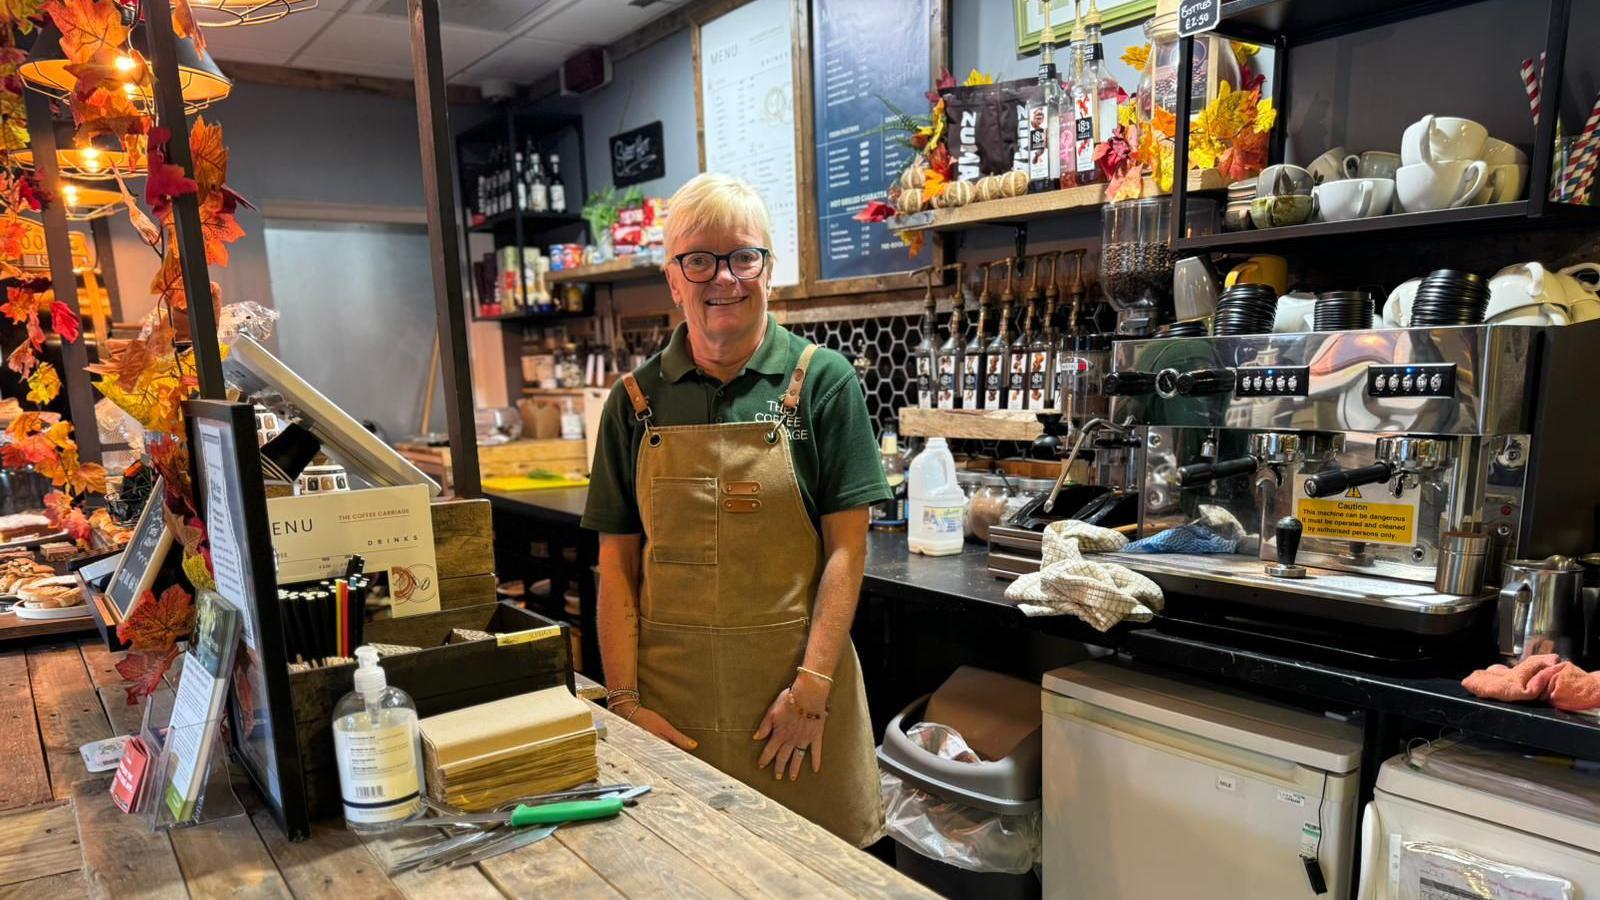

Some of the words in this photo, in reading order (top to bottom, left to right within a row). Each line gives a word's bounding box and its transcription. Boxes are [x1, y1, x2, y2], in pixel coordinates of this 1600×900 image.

[710, 43, 738, 64] MENU
[958, 111, 980, 181] ZUMA
[1337, 502, 1368, 511] Caution
[352, 511, 376, 520] COFFEE
[377, 508, 410, 517] CARRIAGE
[1369, 513, 1406, 522] dangerous
[272, 518, 313, 536] ENU
[1316, 526, 1350, 534] authorised
[1352, 529, 1379, 537] persons
[1378, 522, 1406, 531] cleaned
[367, 535, 419, 546] DRINKS
